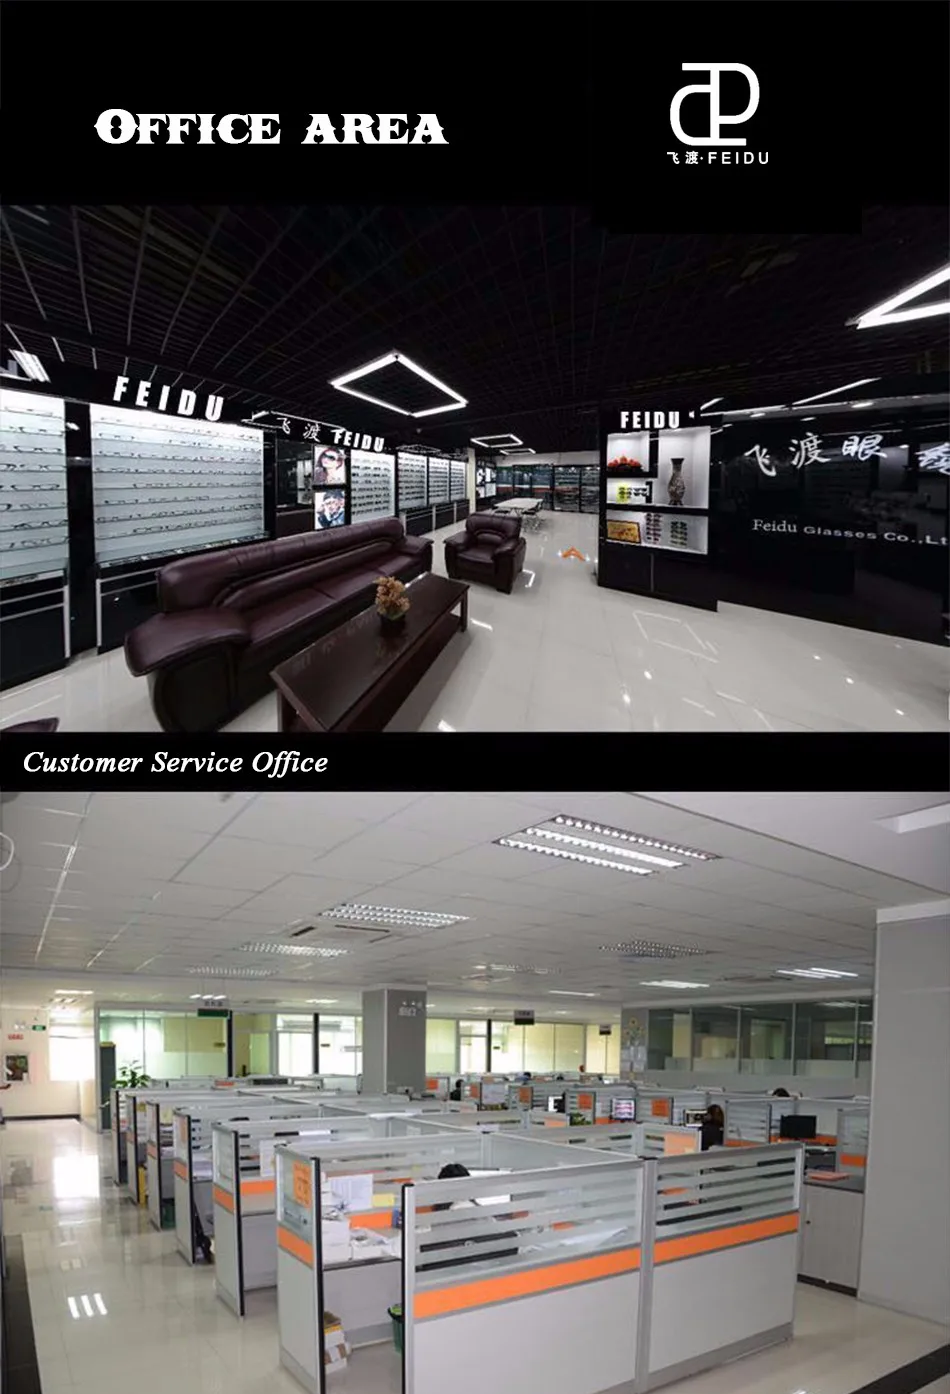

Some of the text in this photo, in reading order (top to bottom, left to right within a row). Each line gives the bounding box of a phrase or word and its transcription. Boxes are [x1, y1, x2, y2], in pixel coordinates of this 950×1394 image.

[112, 375, 224, 422] FEIDU
[620, 411, 680, 429] FEIDU
[333, 428, 385, 453] FEIDU
[752, 518, 798, 533] Feidu
[803, 526, 877, 540] Glasses
